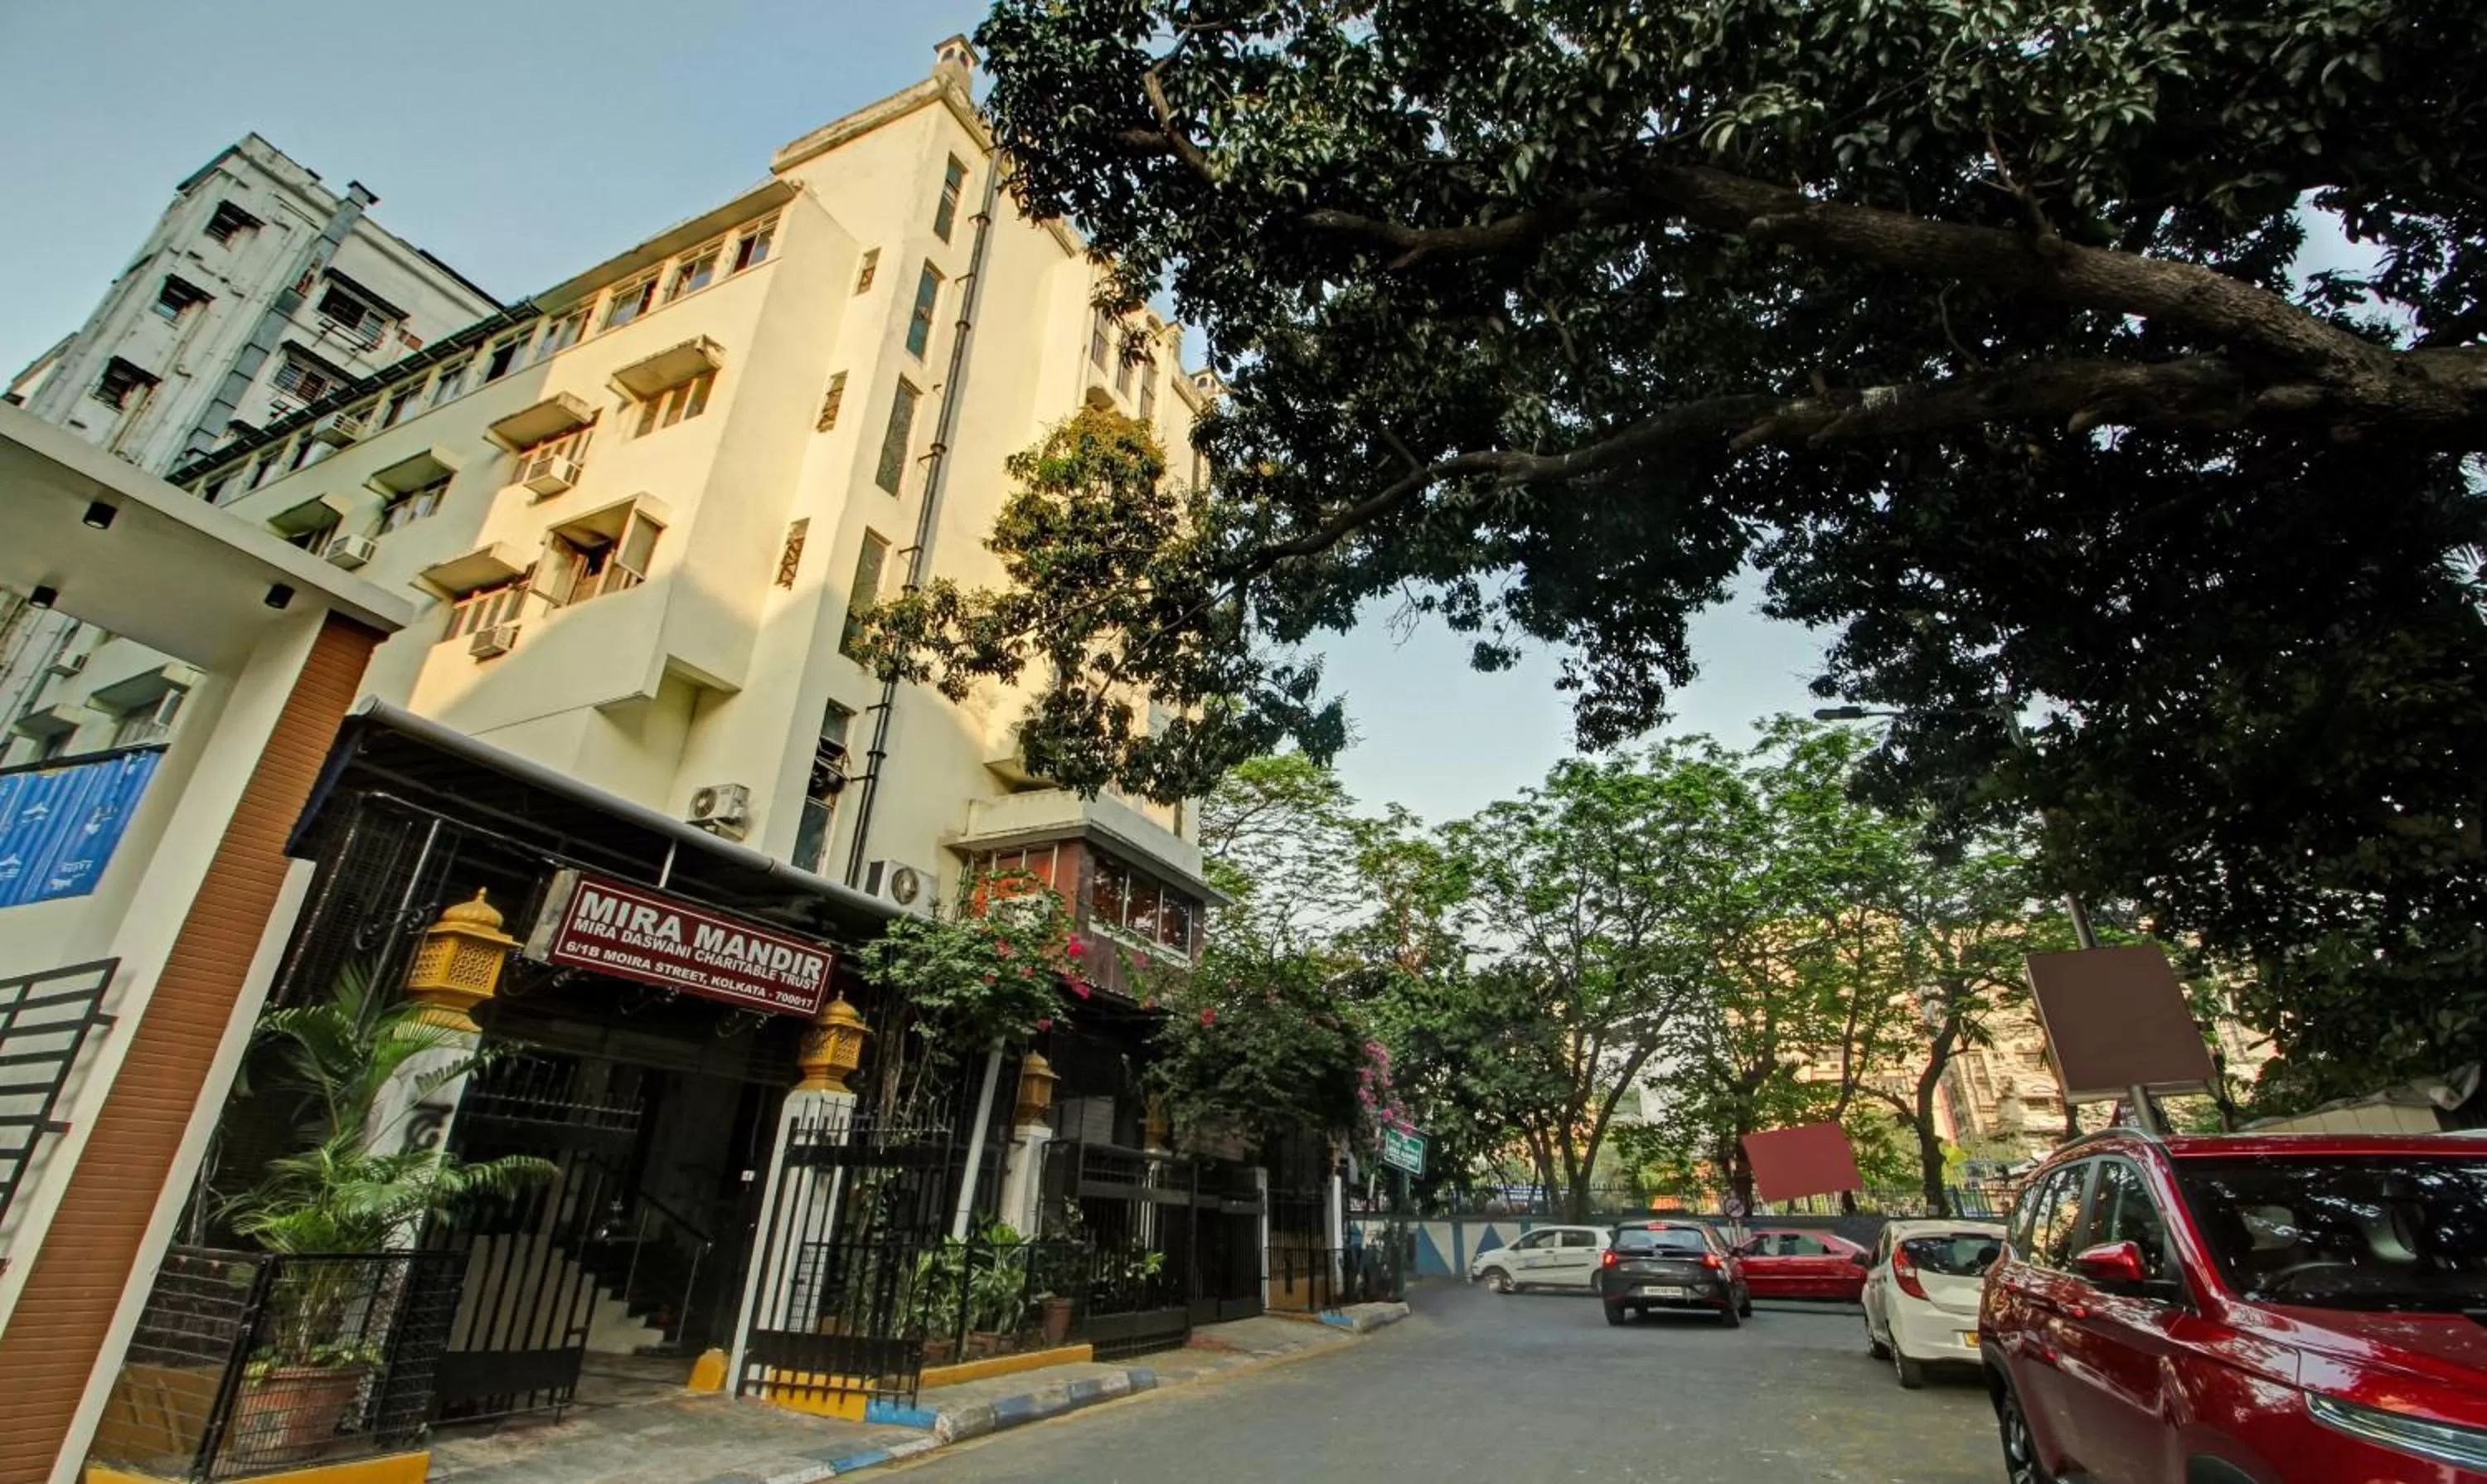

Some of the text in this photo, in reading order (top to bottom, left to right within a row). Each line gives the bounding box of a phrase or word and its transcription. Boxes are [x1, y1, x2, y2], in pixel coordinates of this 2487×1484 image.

[566, 941, 601, 958] 6/1B
[604, 950, 652, 970] MOIRA
[654, 962, 707, 984] STREET,
[710, 976, 766, 997] KOLKATA
[573, 919, 819, 991] MIRA DASWANI CHARITABLE TRUST
[579, 891, 823, 980] MIRA MANDIR
